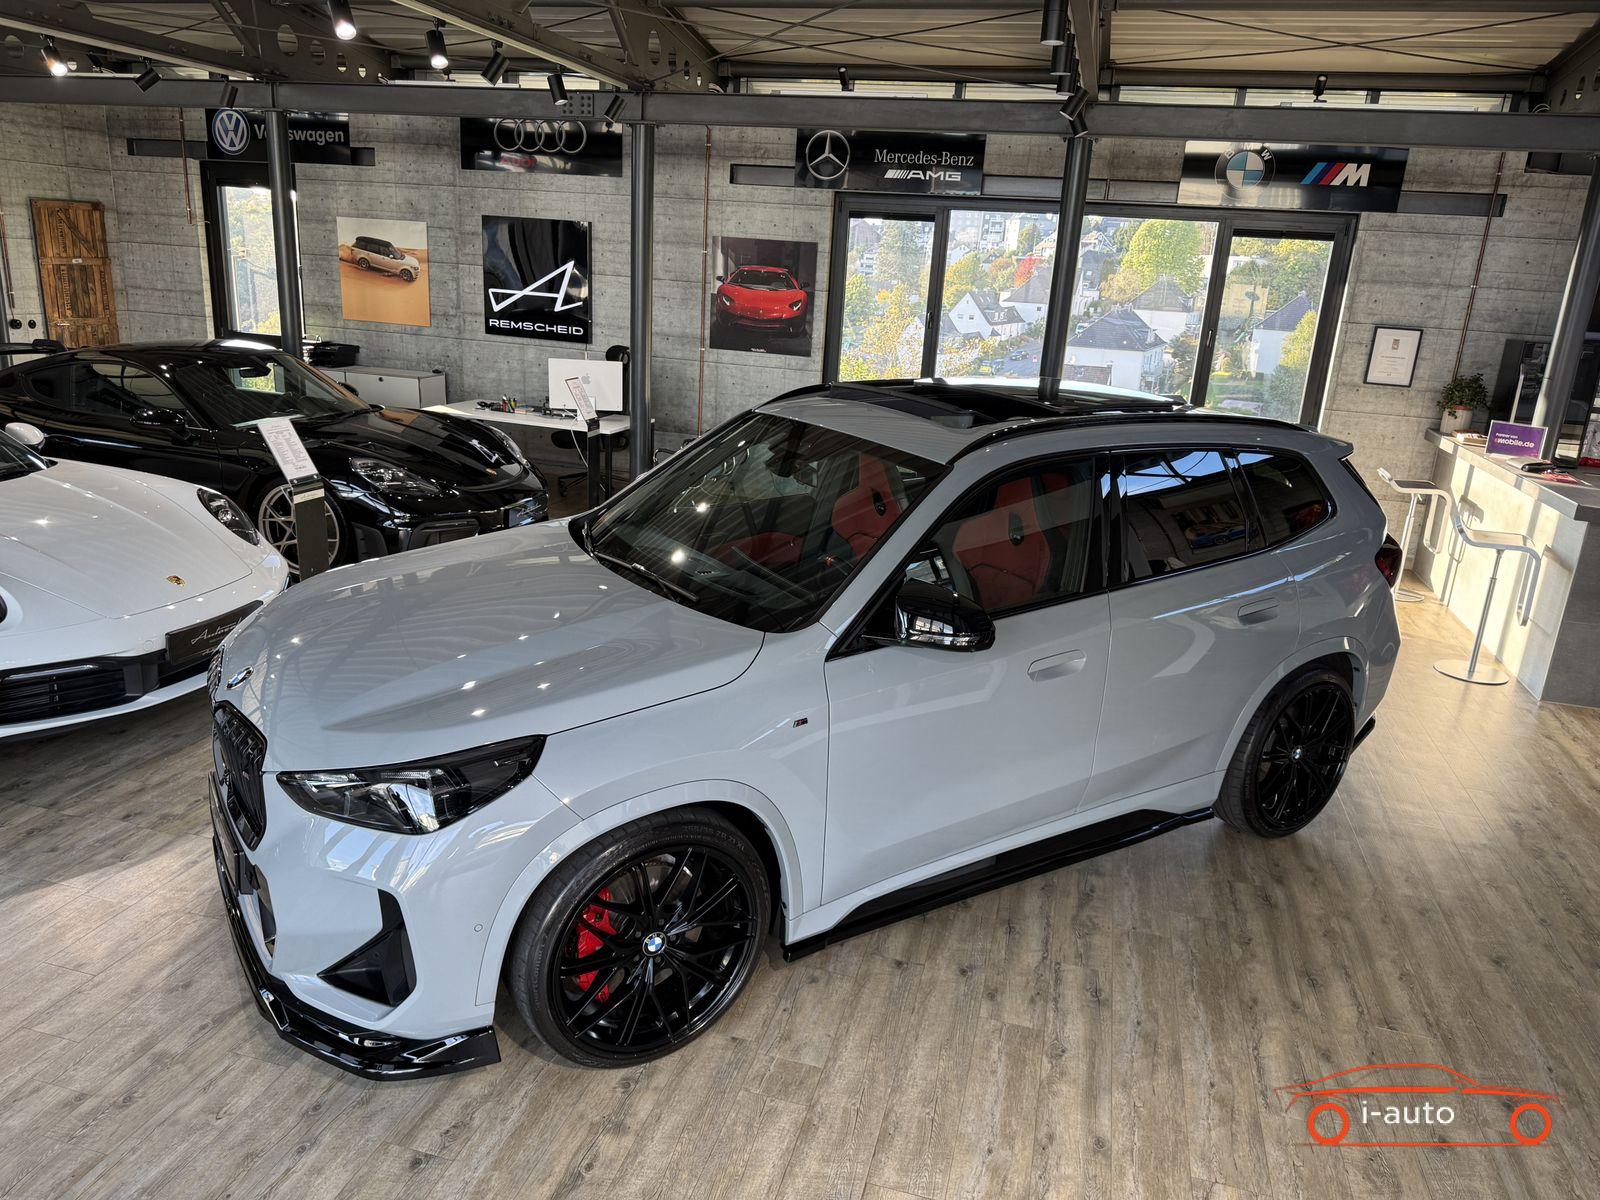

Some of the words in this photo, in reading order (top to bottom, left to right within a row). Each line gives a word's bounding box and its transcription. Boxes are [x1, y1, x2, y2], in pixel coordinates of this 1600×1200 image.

[254, 124, 344, 146] Vswagen
[874, 148, 974, 167] Mercedes-Benz
[906, 169, 962, 181] AMG
[488, 318, 584, 335] REMSCHEID
[1497, 438, 1535, 449] mobile.de
